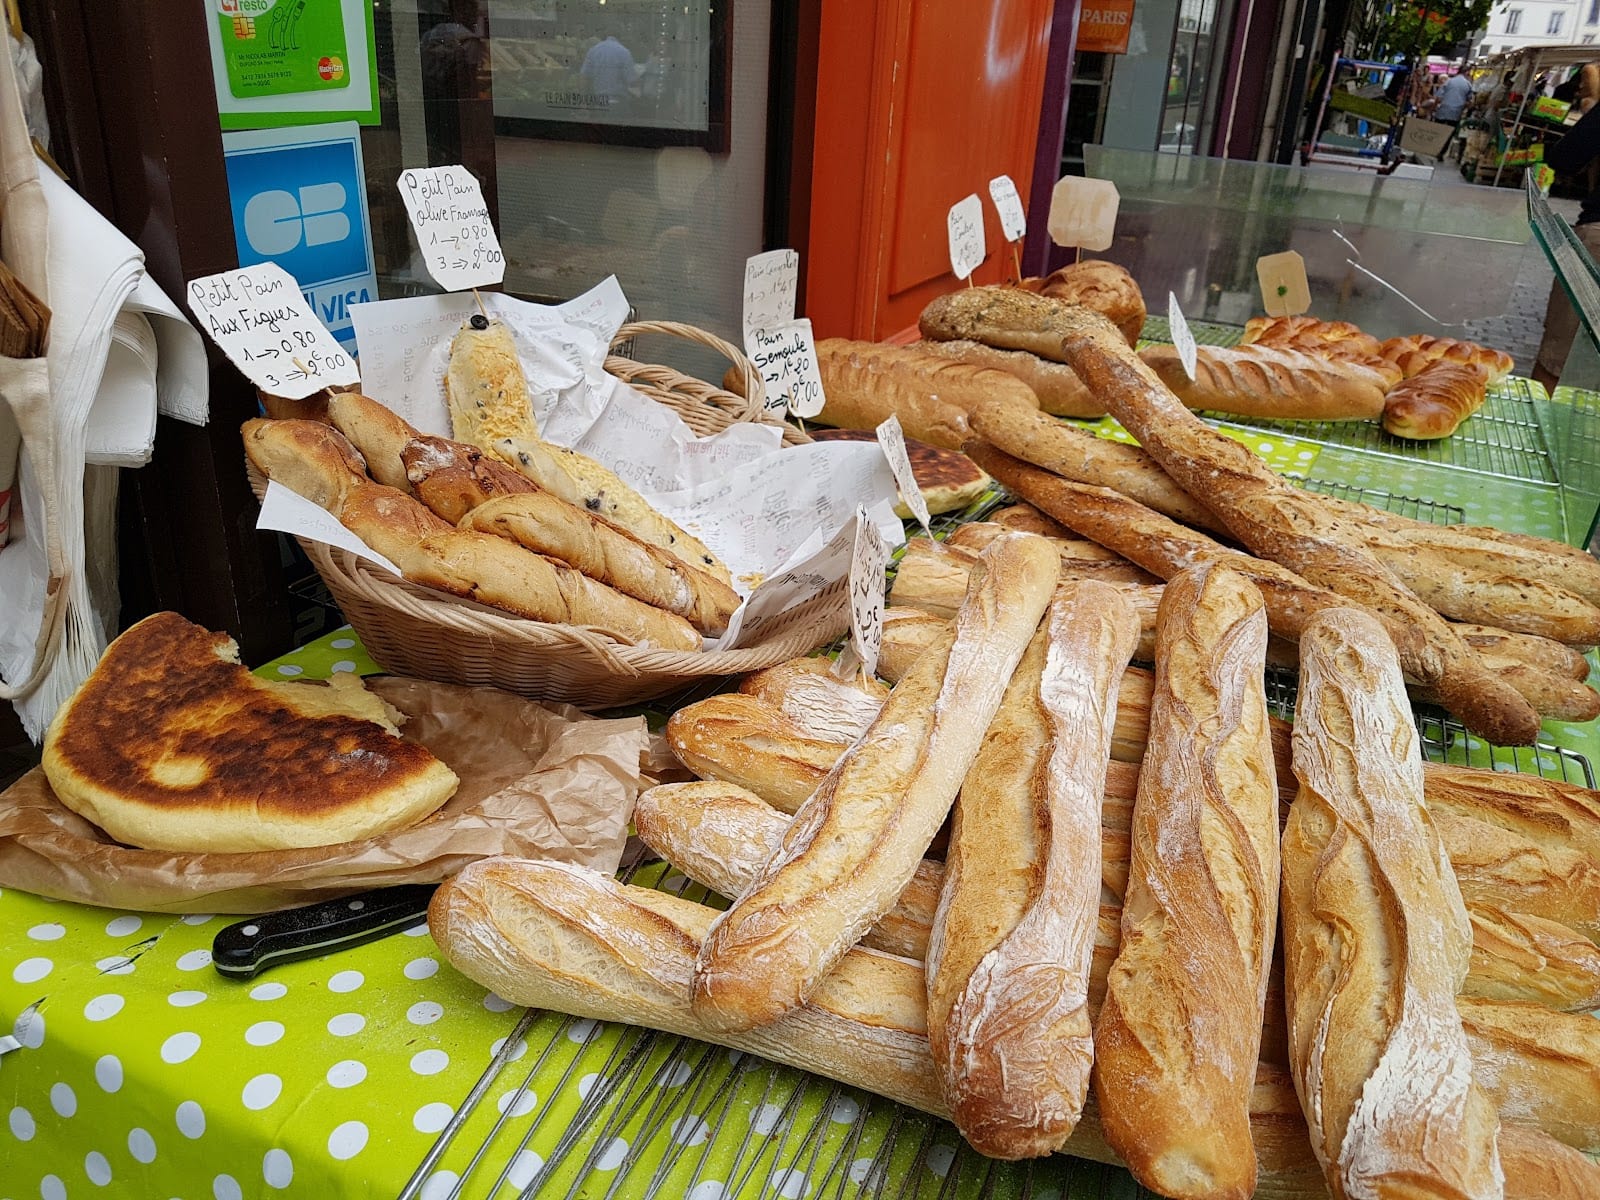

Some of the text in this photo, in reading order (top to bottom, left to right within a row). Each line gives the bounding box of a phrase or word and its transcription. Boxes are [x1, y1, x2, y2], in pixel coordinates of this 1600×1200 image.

[239, 0, 268, 11] resto
[1081, 9, 1128, 24] PARIS
[404, 172, 474, 205] Petit Pain
[192, 274, 283, 312] Petit Pain
[209, 306, 300, 337] Aux Figues
[754, 333, 807, 369] Semoule
[756, 328, 783, 348] Pain
